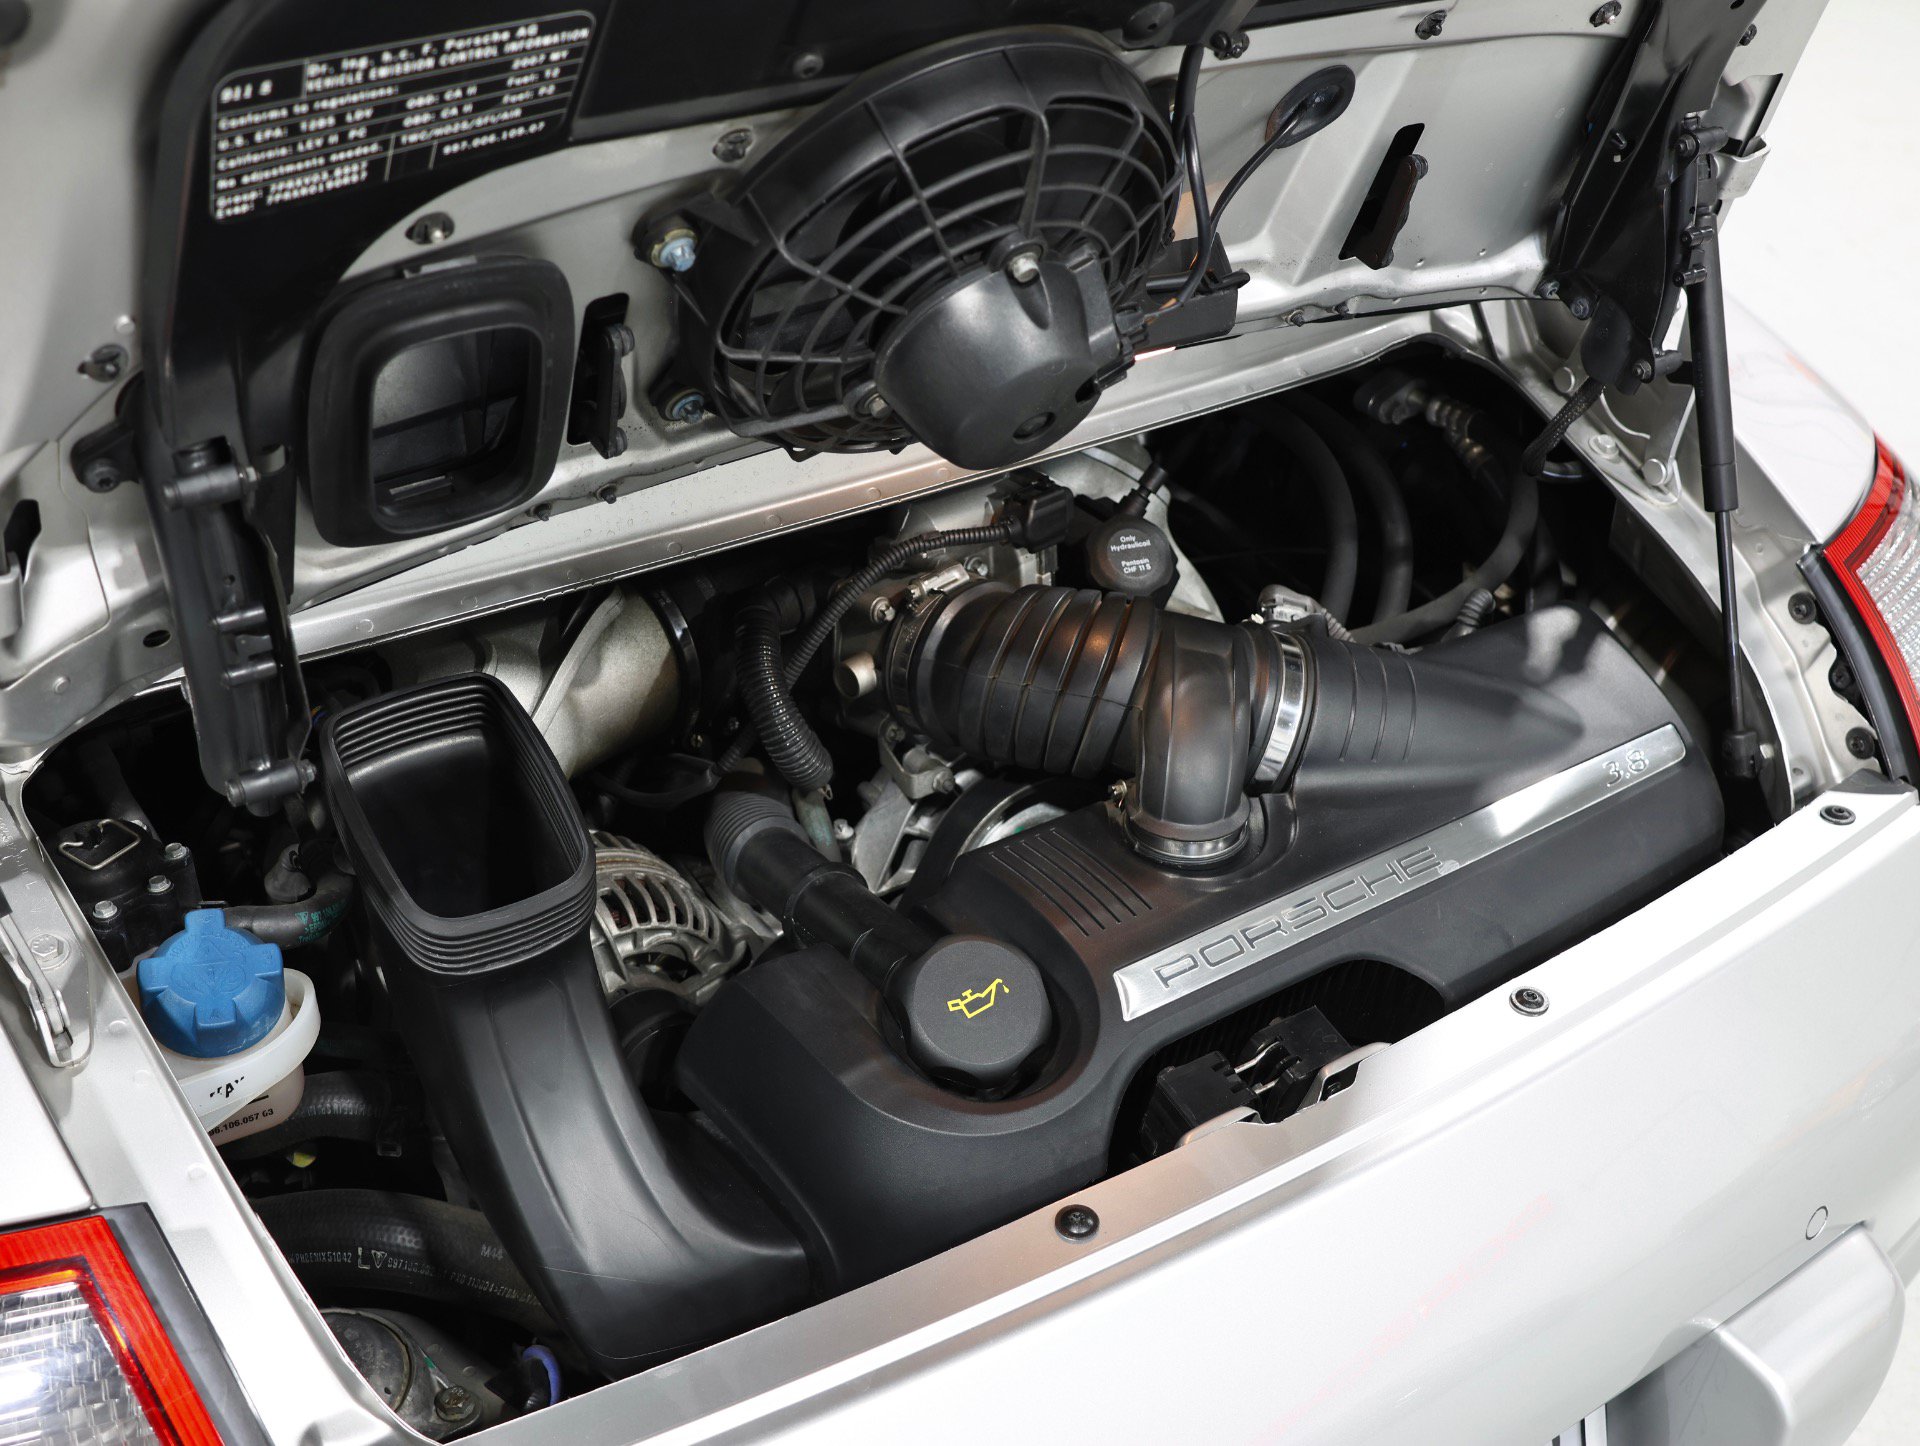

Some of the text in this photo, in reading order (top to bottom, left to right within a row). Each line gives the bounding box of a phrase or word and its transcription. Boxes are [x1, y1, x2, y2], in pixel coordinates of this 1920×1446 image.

[307, 63, 334, 78] Dr.
[341, 55, 375, 70] Ing.
[444, 30, 511, 51] Porsche
[515, 23, 539, 39] AG
[307, 27, 590, 92] VEHICLE EMISSION CONTROL INFORMATION
[217, 135, 249, 151] U.S.
[254, 126, 288, 143] EPA:
[506, 73, 539, 88] Fuel:
[218, 85, 399, 131] Conforms to regulations:
[220, 83, 253, 104] 911
[217, 145, 293, 172] California:
[297, 136, 324, 153] LEV
[502, 90, 534, 105] Fuel:
[216, 177, 237, 191] No
[241, 156, 326, 185] adjustments
[329, 142, 384, 163] needed.
[216, 190, 263, 209] Group:
[216, 202, 255, 220] Evap:
[1110, 539, 1151, 551] Hydraulicoil
[1120, 535, 1135, 543] Only
[1121, 558, 1149, 567] Pentosin
[1123, 566, 1137, 574] CHF
[1602, 749, 1649, 787] 3.8
[1152, 846, 1444, 991] PORSCHE
